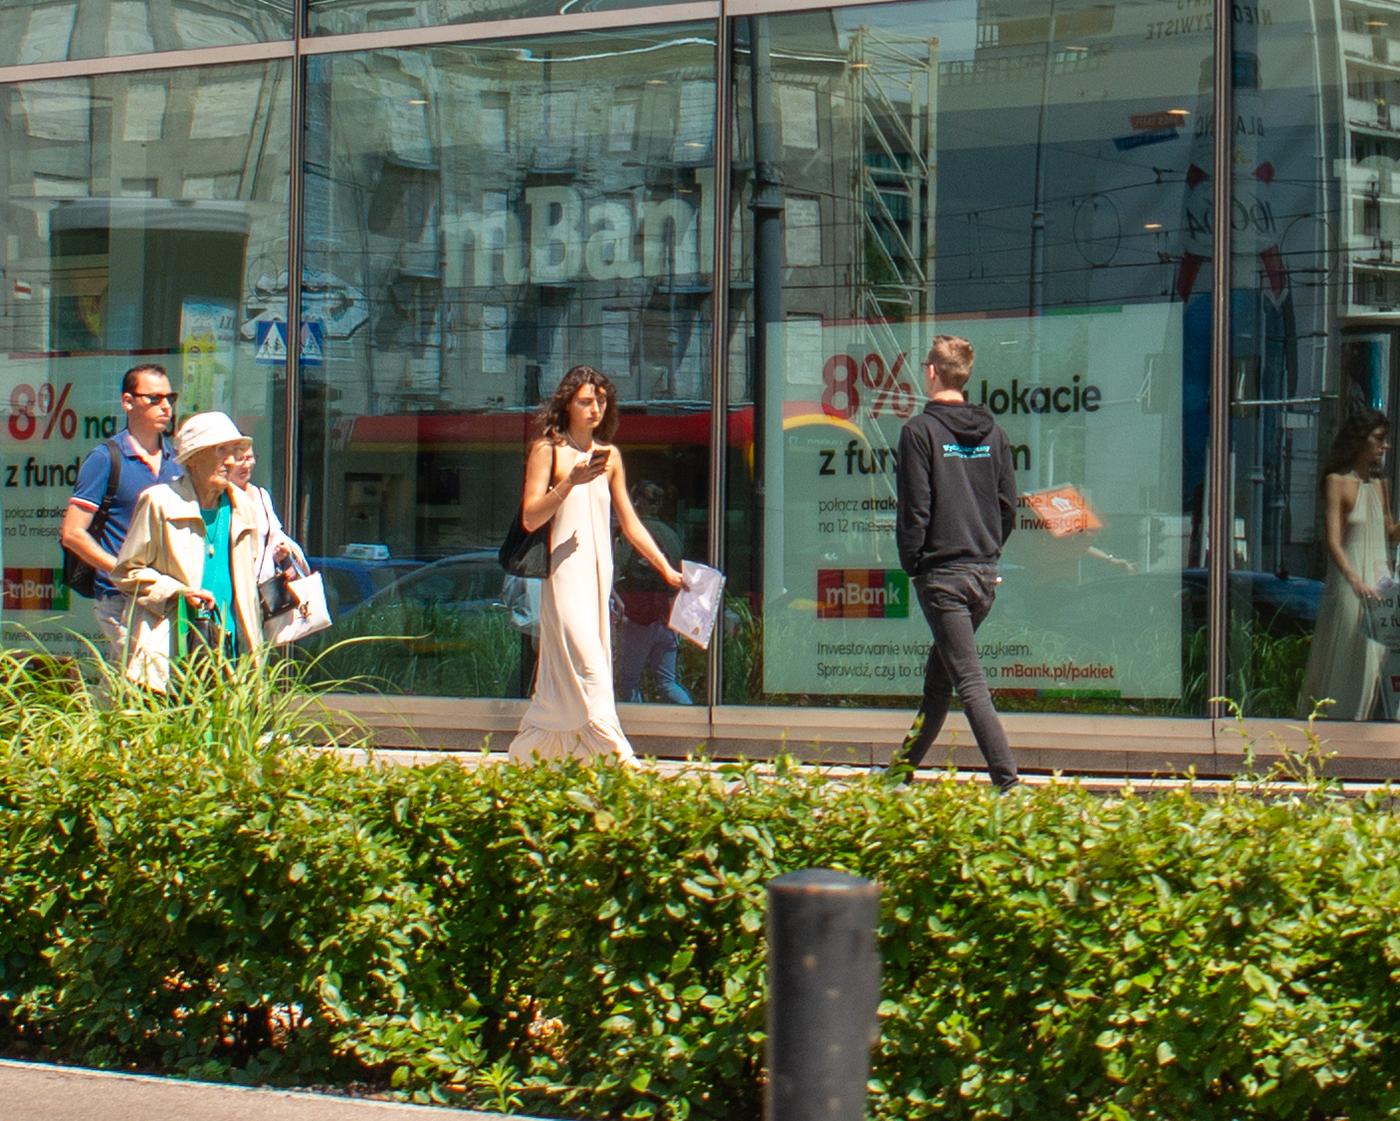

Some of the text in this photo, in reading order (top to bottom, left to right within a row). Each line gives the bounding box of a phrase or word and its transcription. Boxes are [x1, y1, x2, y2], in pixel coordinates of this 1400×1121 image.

[821, 352, 1102, 420] 8% lokacie
[8, 382, 78, 441] 8%
[84, 414, 118, 440] na
[819, 449, 836, 475] z
[5, 464, 19, 488] z
[36, 505, 68, 519] atrakc
[818, 497, 859, 515] połącz
[861, 496, 898, 511] atrak
[4, 527, 17, 537] na
[19, 524, 28, 537] 12
[818, 521, 835, 533] na
[837, 519, 849, 533] 12
[9, 578, 64, 600] mBank
[825, 582, 902, 606] mBank
[1380, 616, 1388, 627] z
[817, 641, 1033, 659] Inwestowanie wiąż yzykiem.
[816, 662, 872, 679] Sprawdź,
[874, 667, 896, 681] czy
[898, 664, 912, 677] to
[1001, 661, 1115, 682] mBank.pl/pakiet
